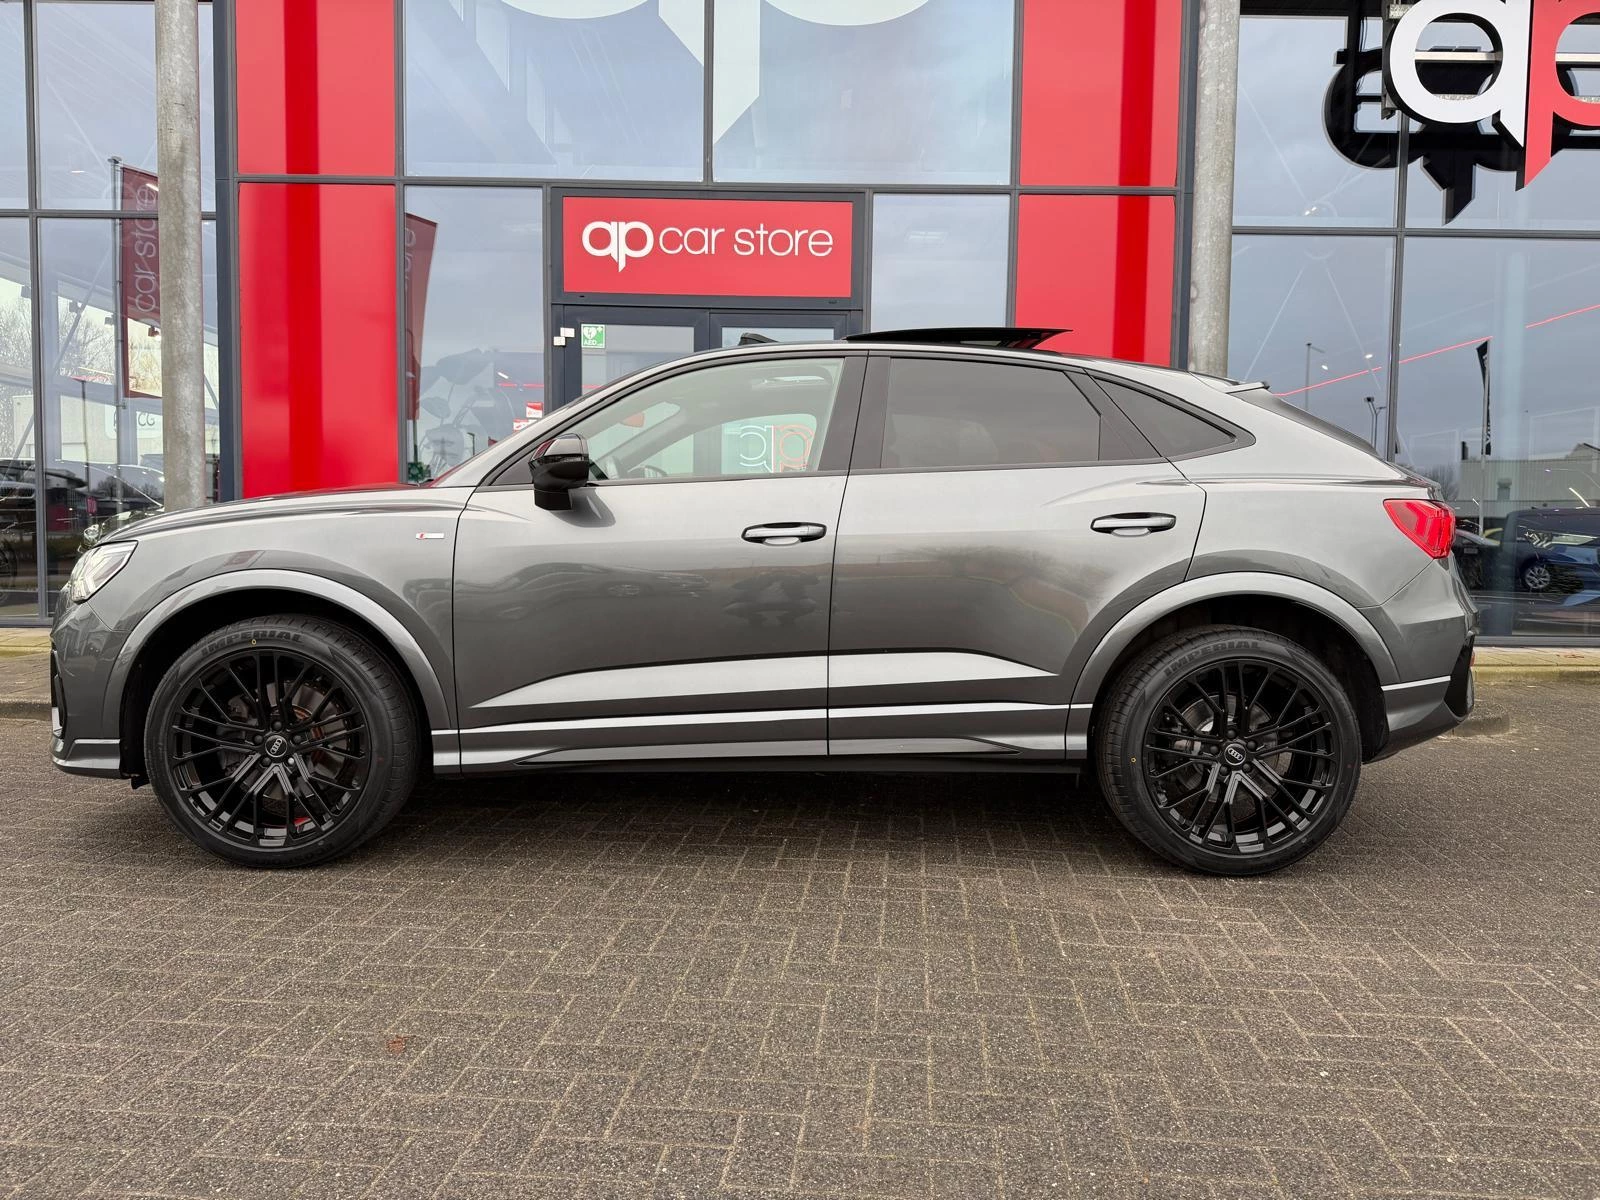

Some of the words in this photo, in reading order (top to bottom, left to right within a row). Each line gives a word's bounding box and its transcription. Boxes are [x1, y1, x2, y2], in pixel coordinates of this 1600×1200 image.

[581, 220, 654, 272] ap
[658, 226, 726, 255] car
[733, 223, 834, 257] store
[201, 629, 304, 657] IMPERIAL
[1163, 640, 1260, 677] IMPERIAL
